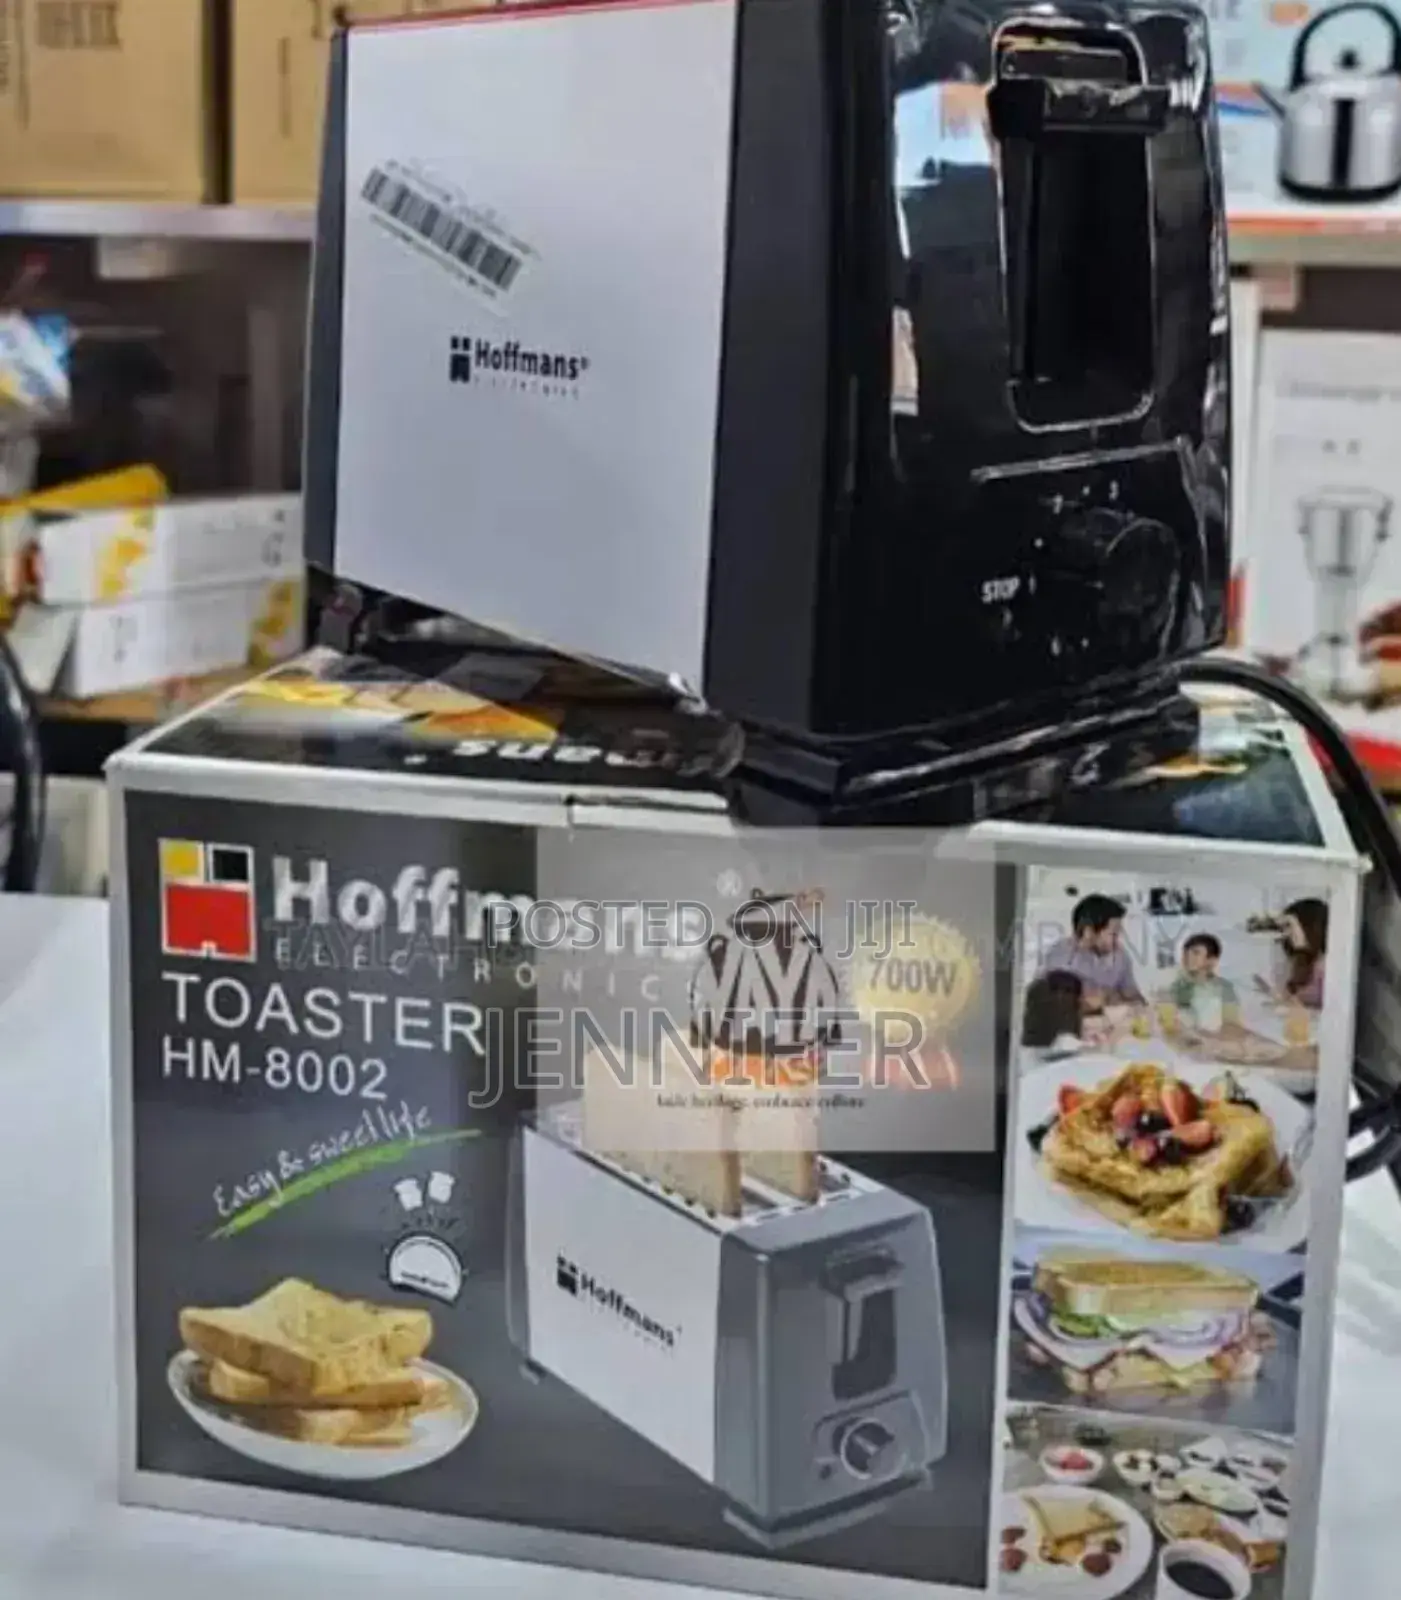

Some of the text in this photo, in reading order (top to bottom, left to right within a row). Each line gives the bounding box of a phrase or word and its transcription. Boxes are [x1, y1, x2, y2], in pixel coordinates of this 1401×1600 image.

[475, 338, 578, 380] Hoffmans
[981, 575, 1021, 605] STOP
[868, 952, 959, 1000] 700W
[161, 970, 486, 1056] TOASTER
[162, 1034, 388, 1100] HM-8002
[213, 1169, 284, 1218] Easy
[580, 1271, 675, 1347] Hoffmans
